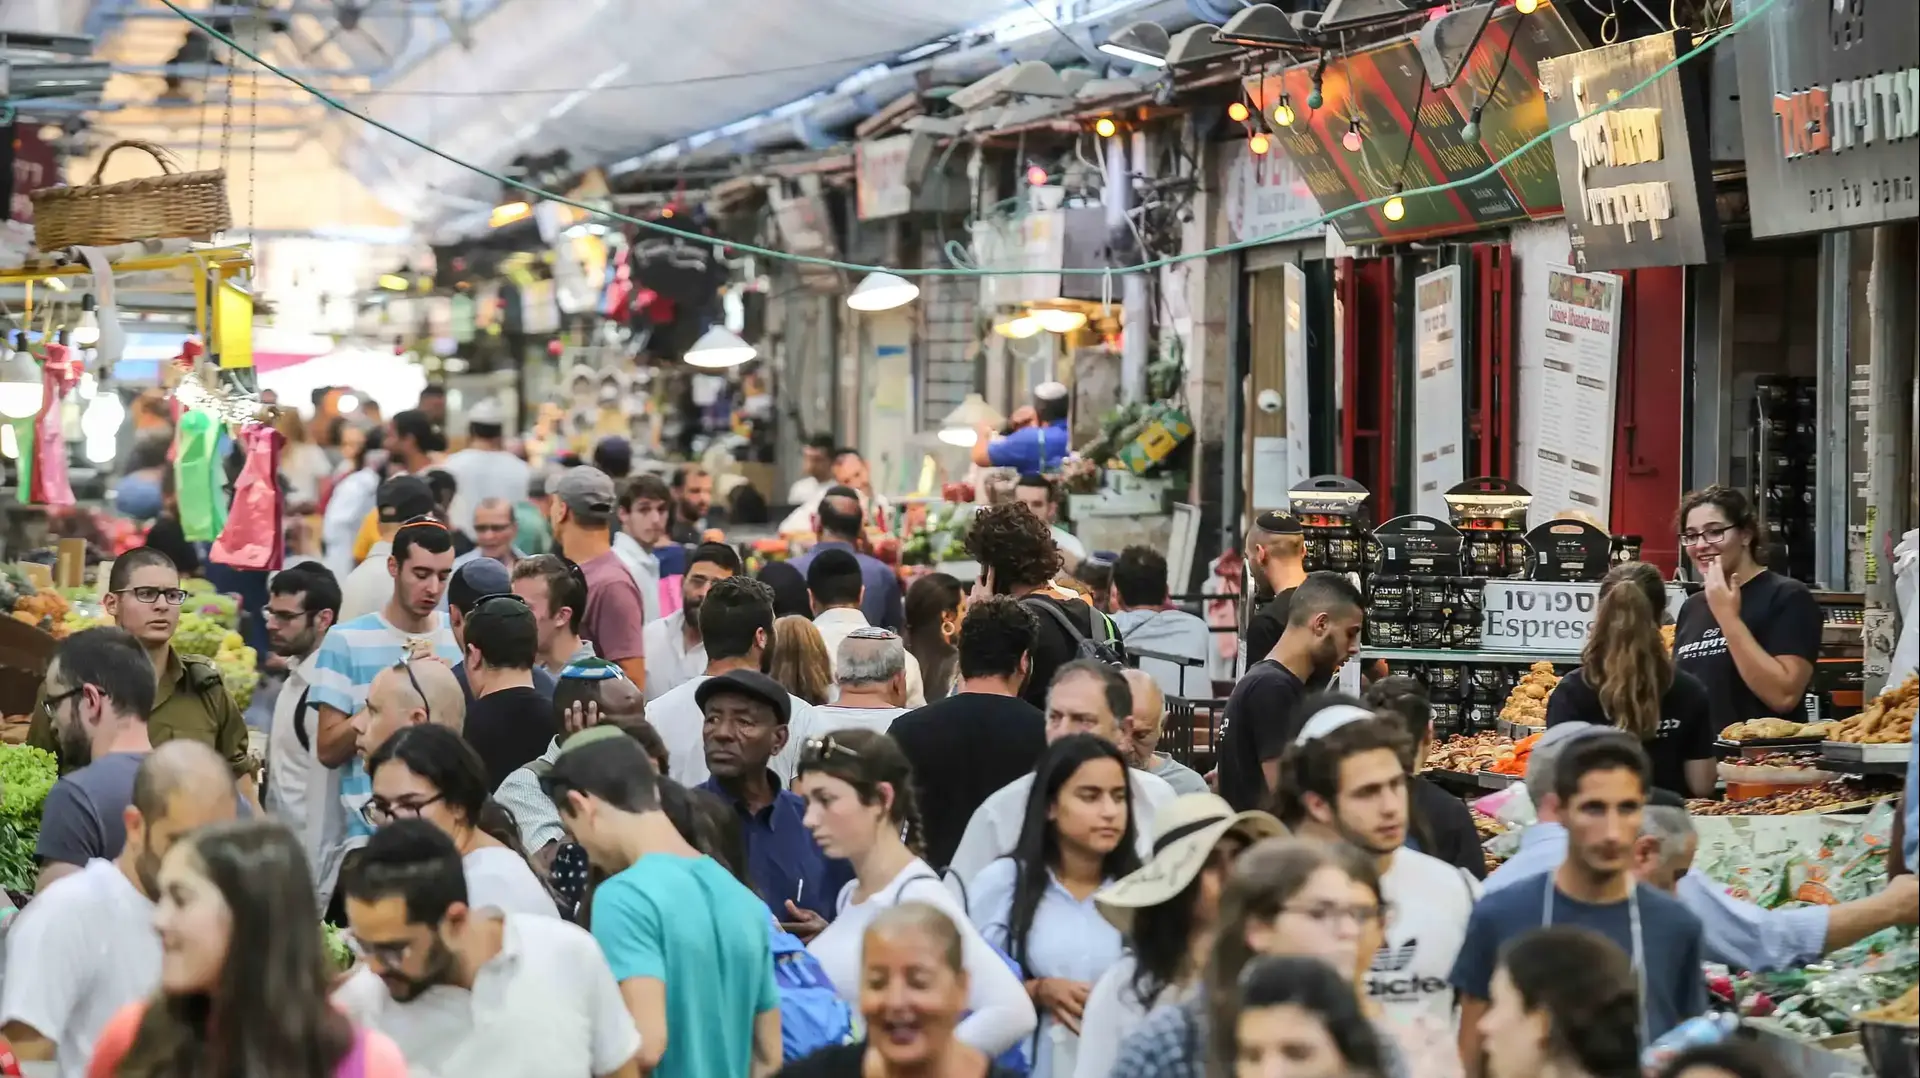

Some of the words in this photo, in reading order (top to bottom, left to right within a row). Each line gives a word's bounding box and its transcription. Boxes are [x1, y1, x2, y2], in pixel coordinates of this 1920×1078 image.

[1841, 177, 1861, 208] של
[1549, 303, 1567, 325] Cuisine
[1567, 307, 1591, 330] libanaise
[1591, 314, 1610, 335] maison
[1504, 590, 1595, 613] ספרסו
[1485, 609, 1596, 646] Espres
